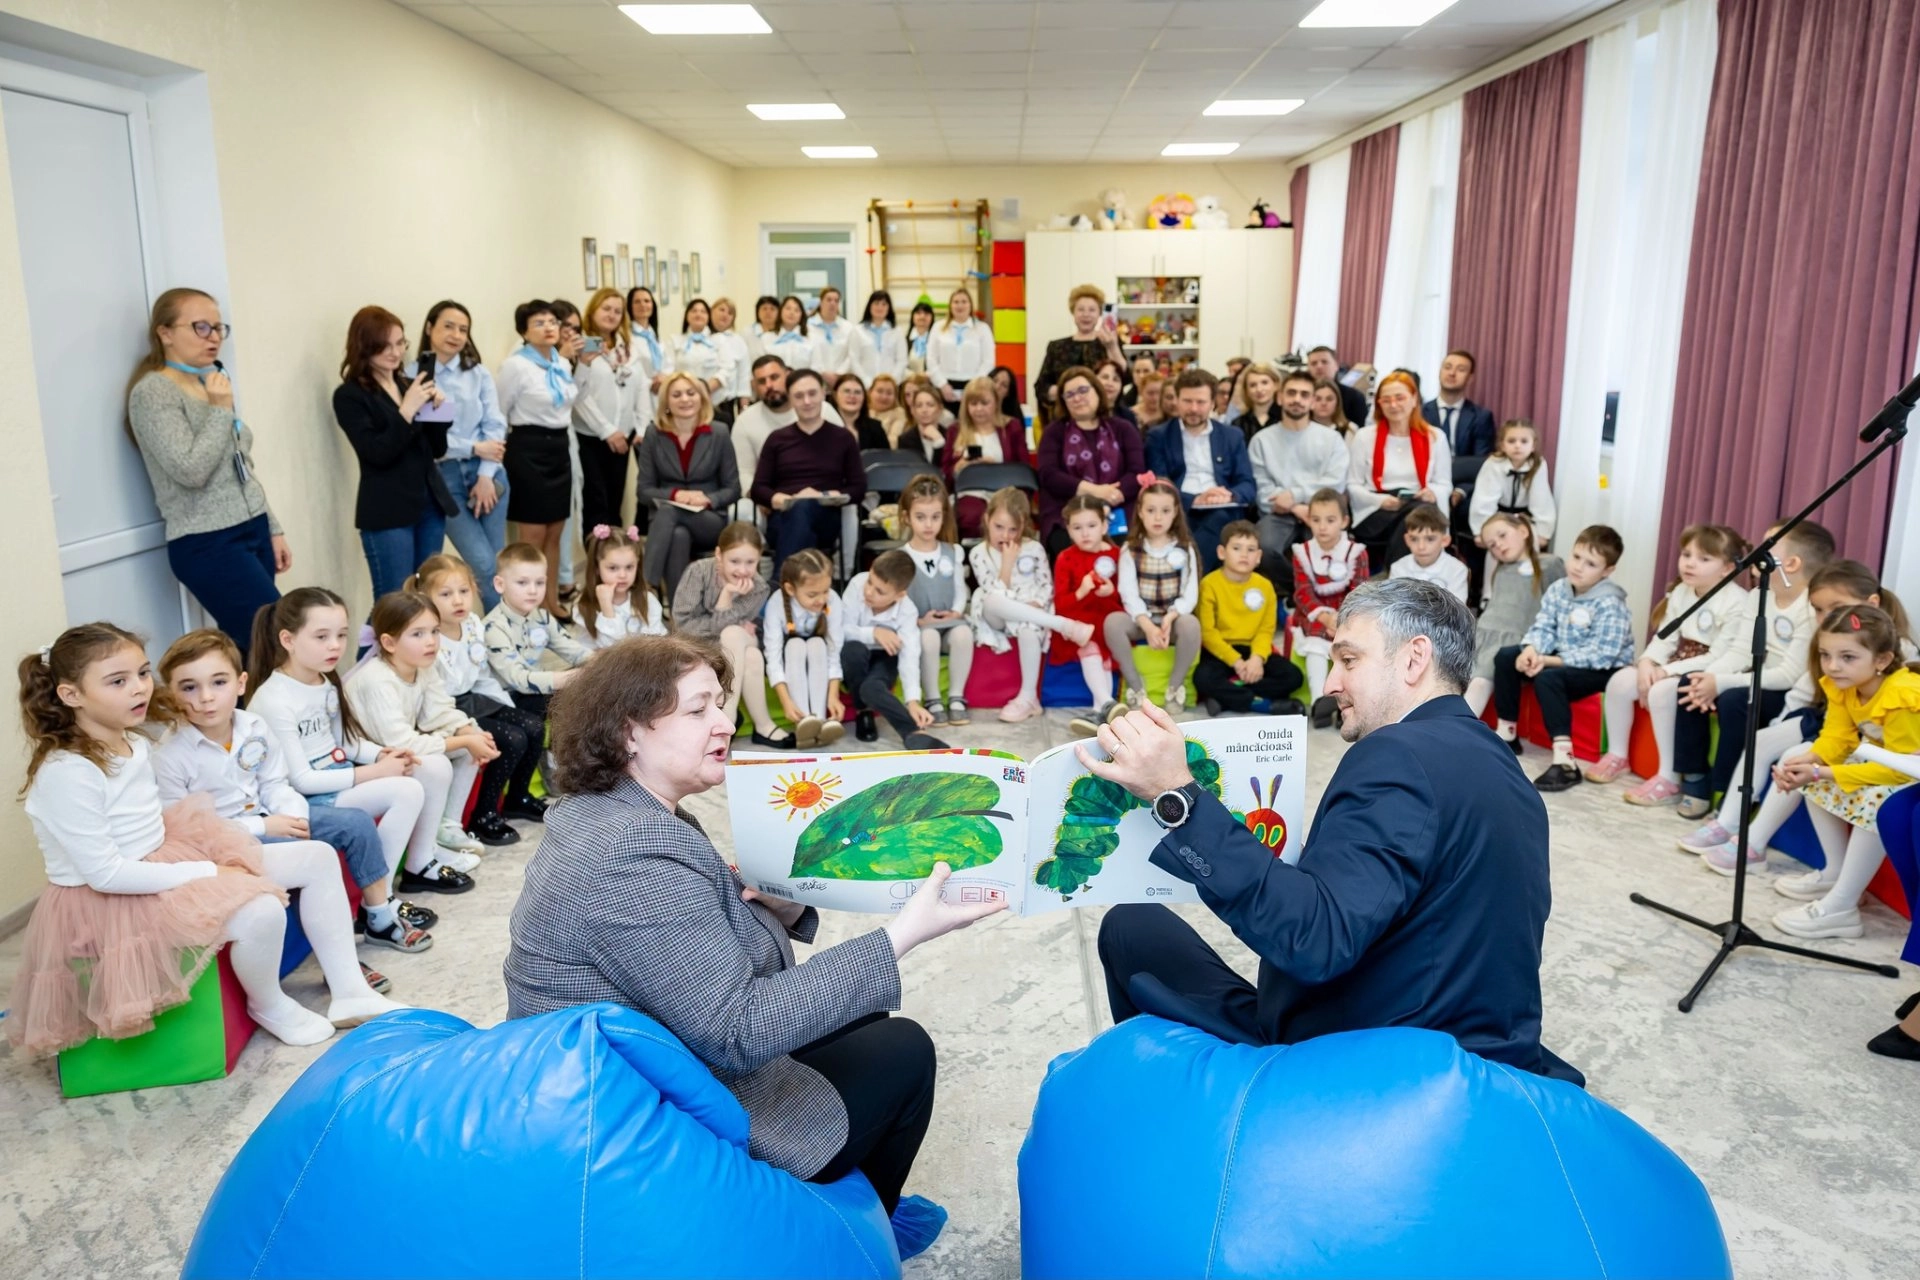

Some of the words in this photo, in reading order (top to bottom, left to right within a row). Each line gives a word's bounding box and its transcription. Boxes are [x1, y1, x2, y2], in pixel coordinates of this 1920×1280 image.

[1257, 728, 1293, 740] Omida
[1225, 741, 1293, 753] mâncăcioasă
[1255, 755, 1271, 763] Eric
[1272, 754, 1293, 762] Carle
[1003, 774, 1025, 783] CARLE
